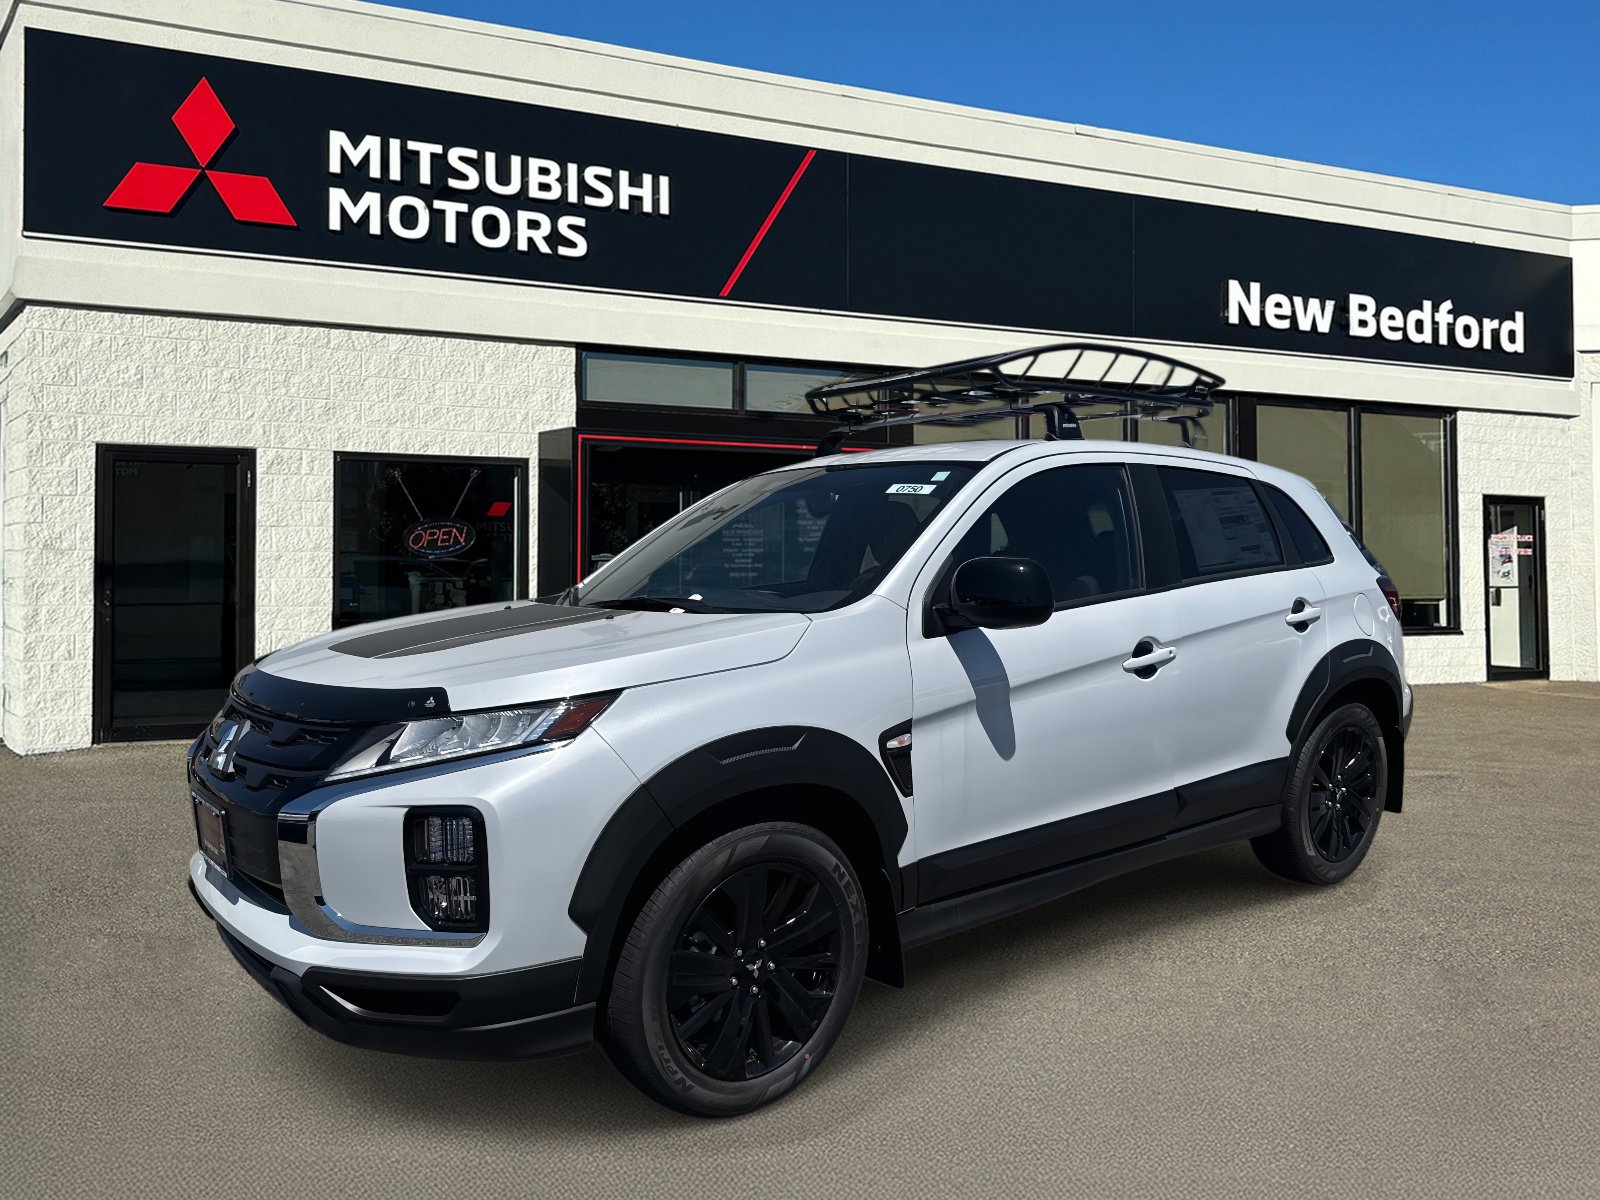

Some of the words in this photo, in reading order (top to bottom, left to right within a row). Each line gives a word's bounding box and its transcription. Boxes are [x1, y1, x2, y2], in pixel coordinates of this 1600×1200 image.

[328, 129, 670, 215] MITSUBISHI
[328, 187, 589, 258] MOTORS
[1228, 279, 1336, 334] New
[1349, 293, 1525, 354] Bedford
[895, 485, 924, 493] 0750
[408, 526, 468, 549] OPEN
